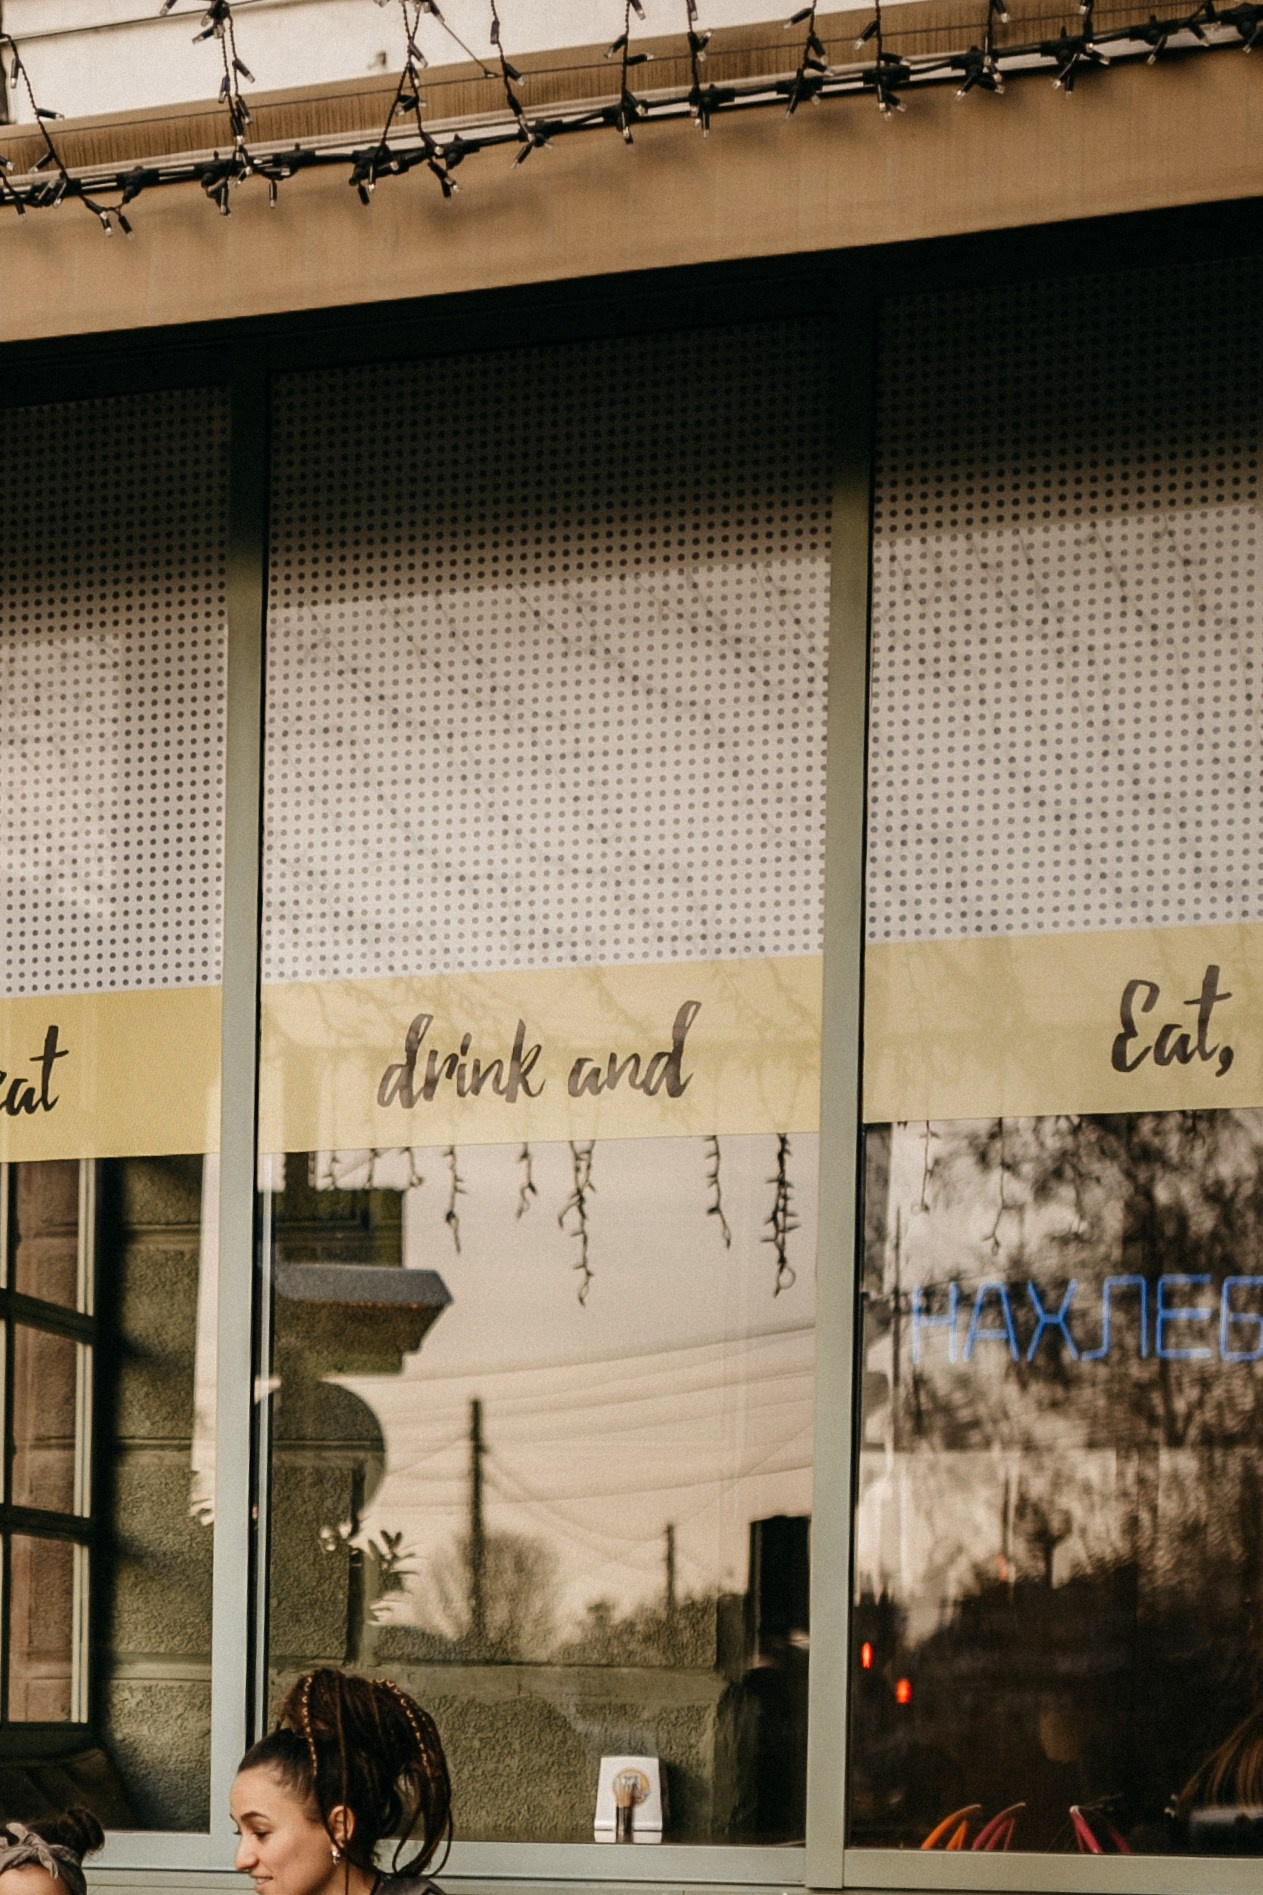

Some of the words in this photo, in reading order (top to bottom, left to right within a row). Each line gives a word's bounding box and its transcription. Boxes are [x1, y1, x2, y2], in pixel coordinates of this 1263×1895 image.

[377, 1013, 546, 1109] drink
[567, 1000, 702, 1098] and
[1111, 964, 1234, 1077] Eat,
